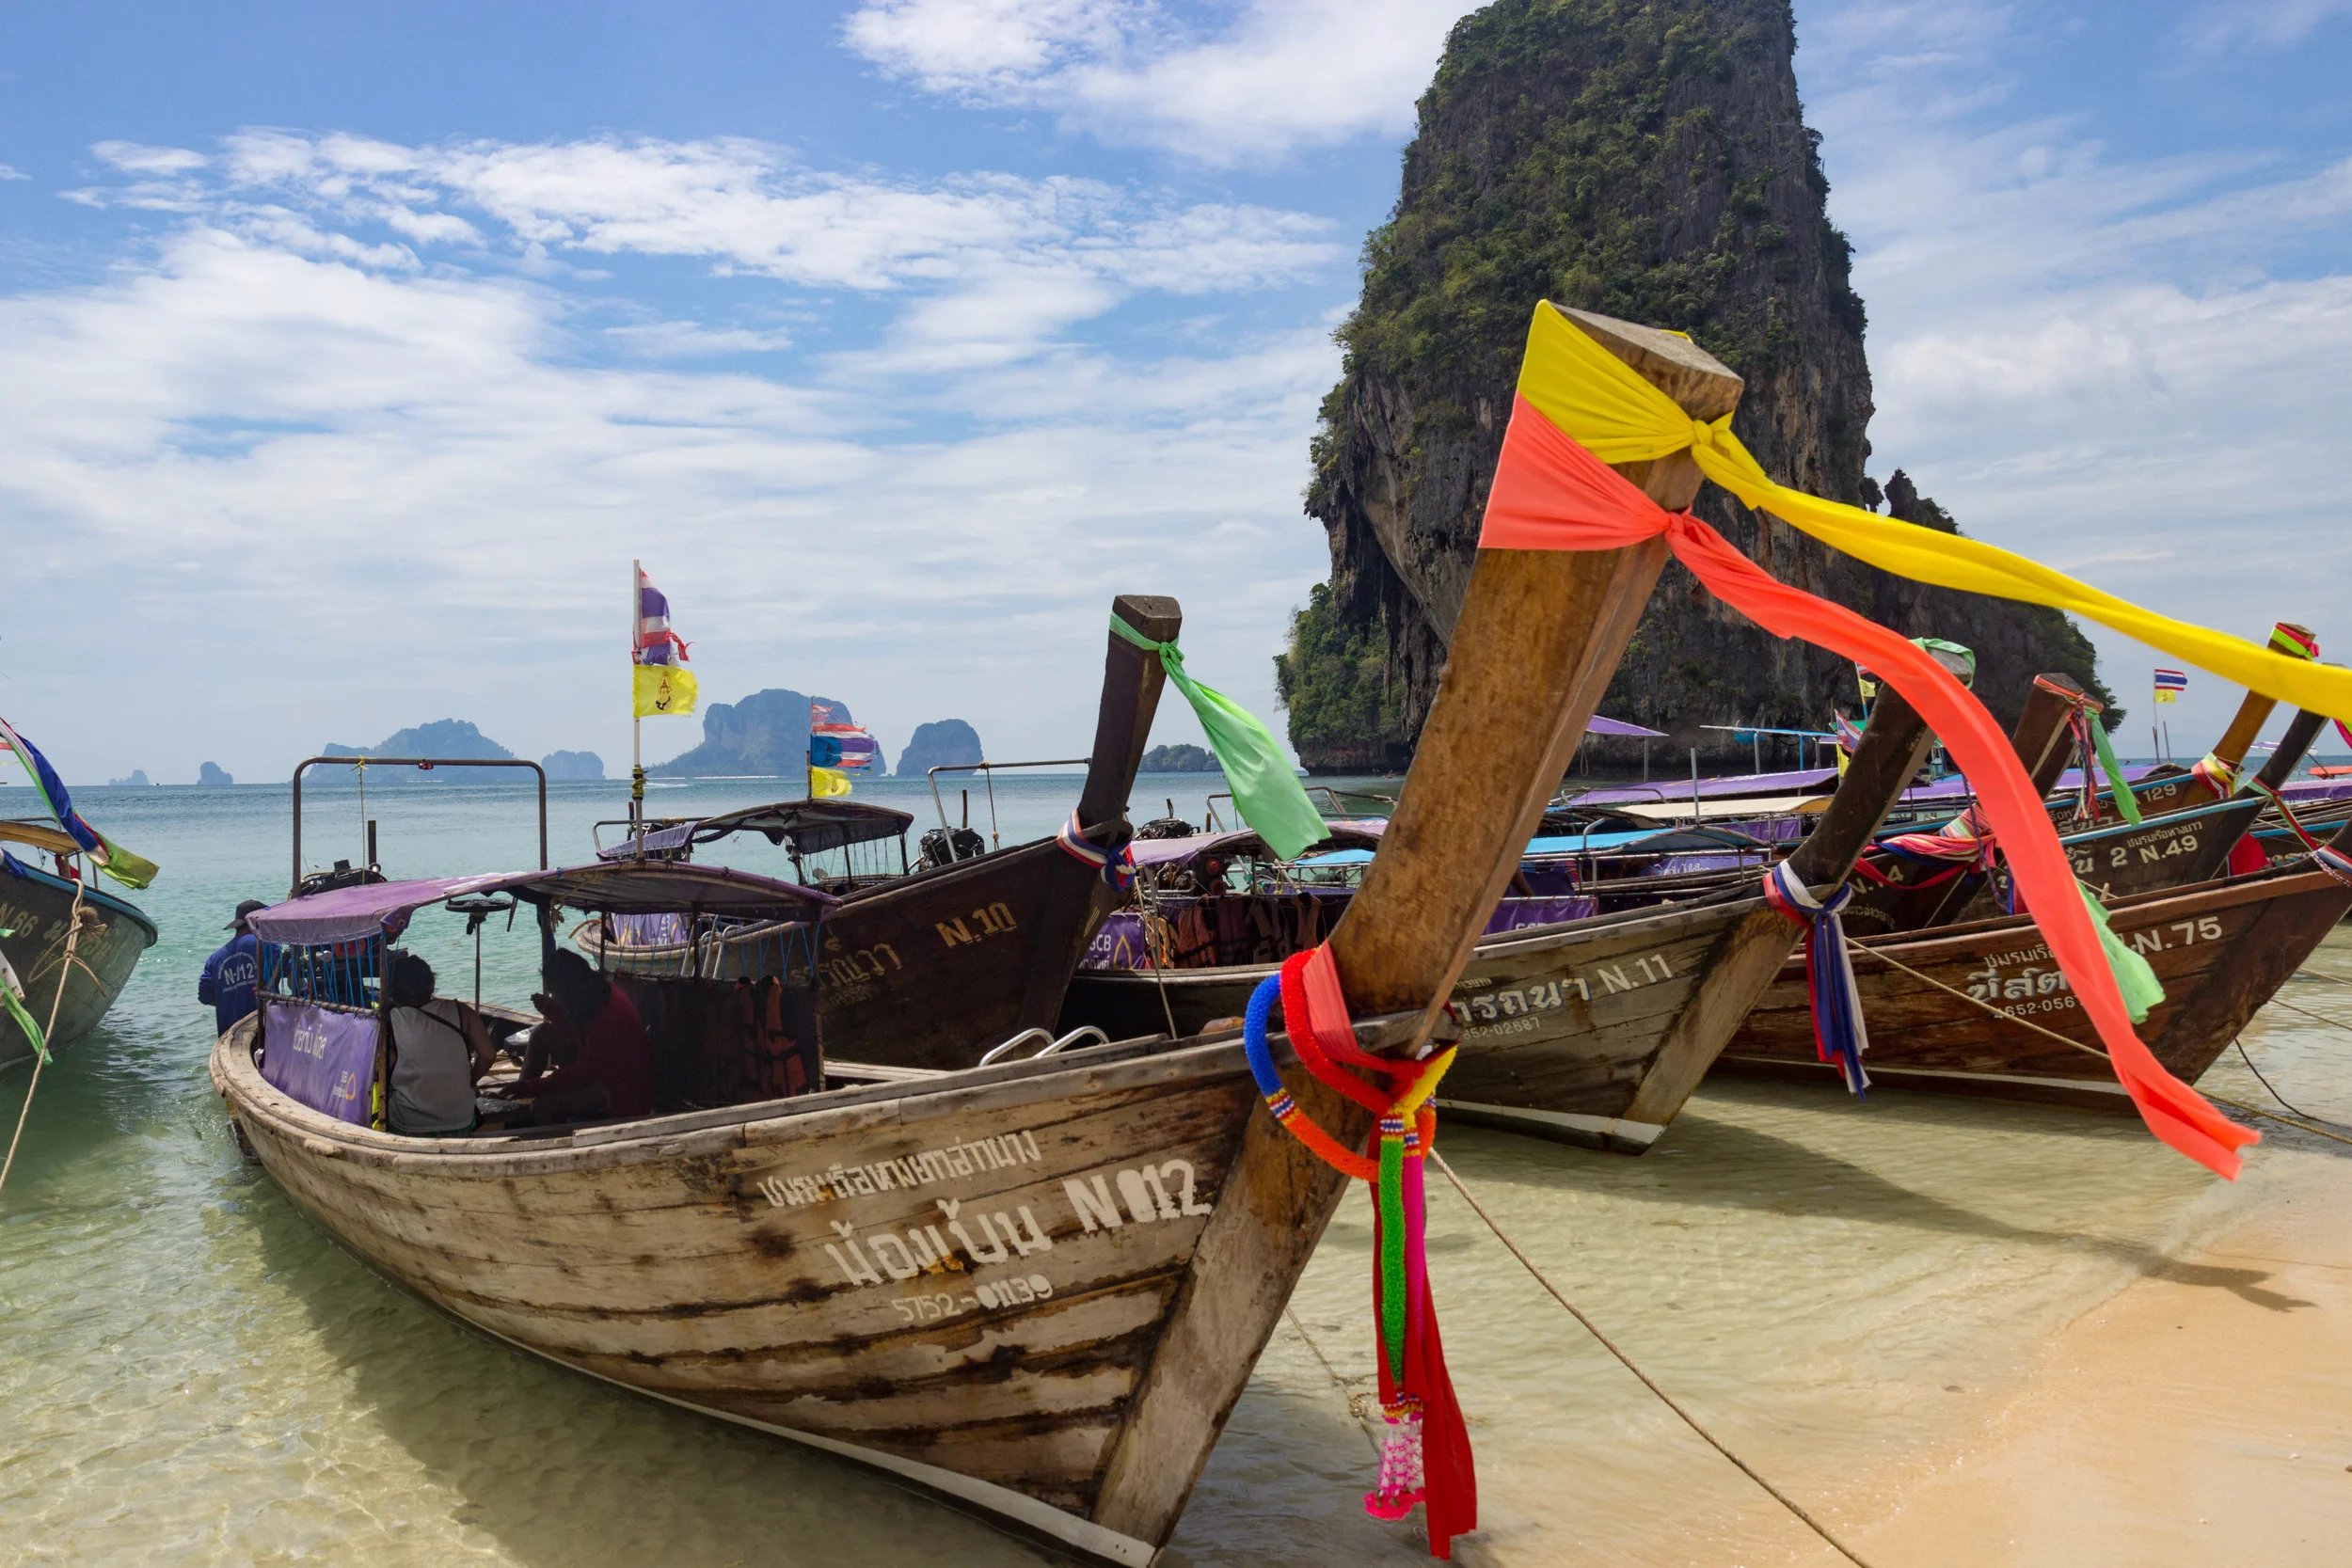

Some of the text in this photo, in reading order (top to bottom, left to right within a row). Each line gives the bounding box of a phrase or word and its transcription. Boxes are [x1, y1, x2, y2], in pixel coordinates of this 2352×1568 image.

[2109, 847, 2128, 867] 2
[2139, 834, 2199, 863] N.49
[935, 901, 1017, 948] N.10
[1597, 954, 1673, 994] N.11
[1994, 995, 2082, 1020] 652-056
